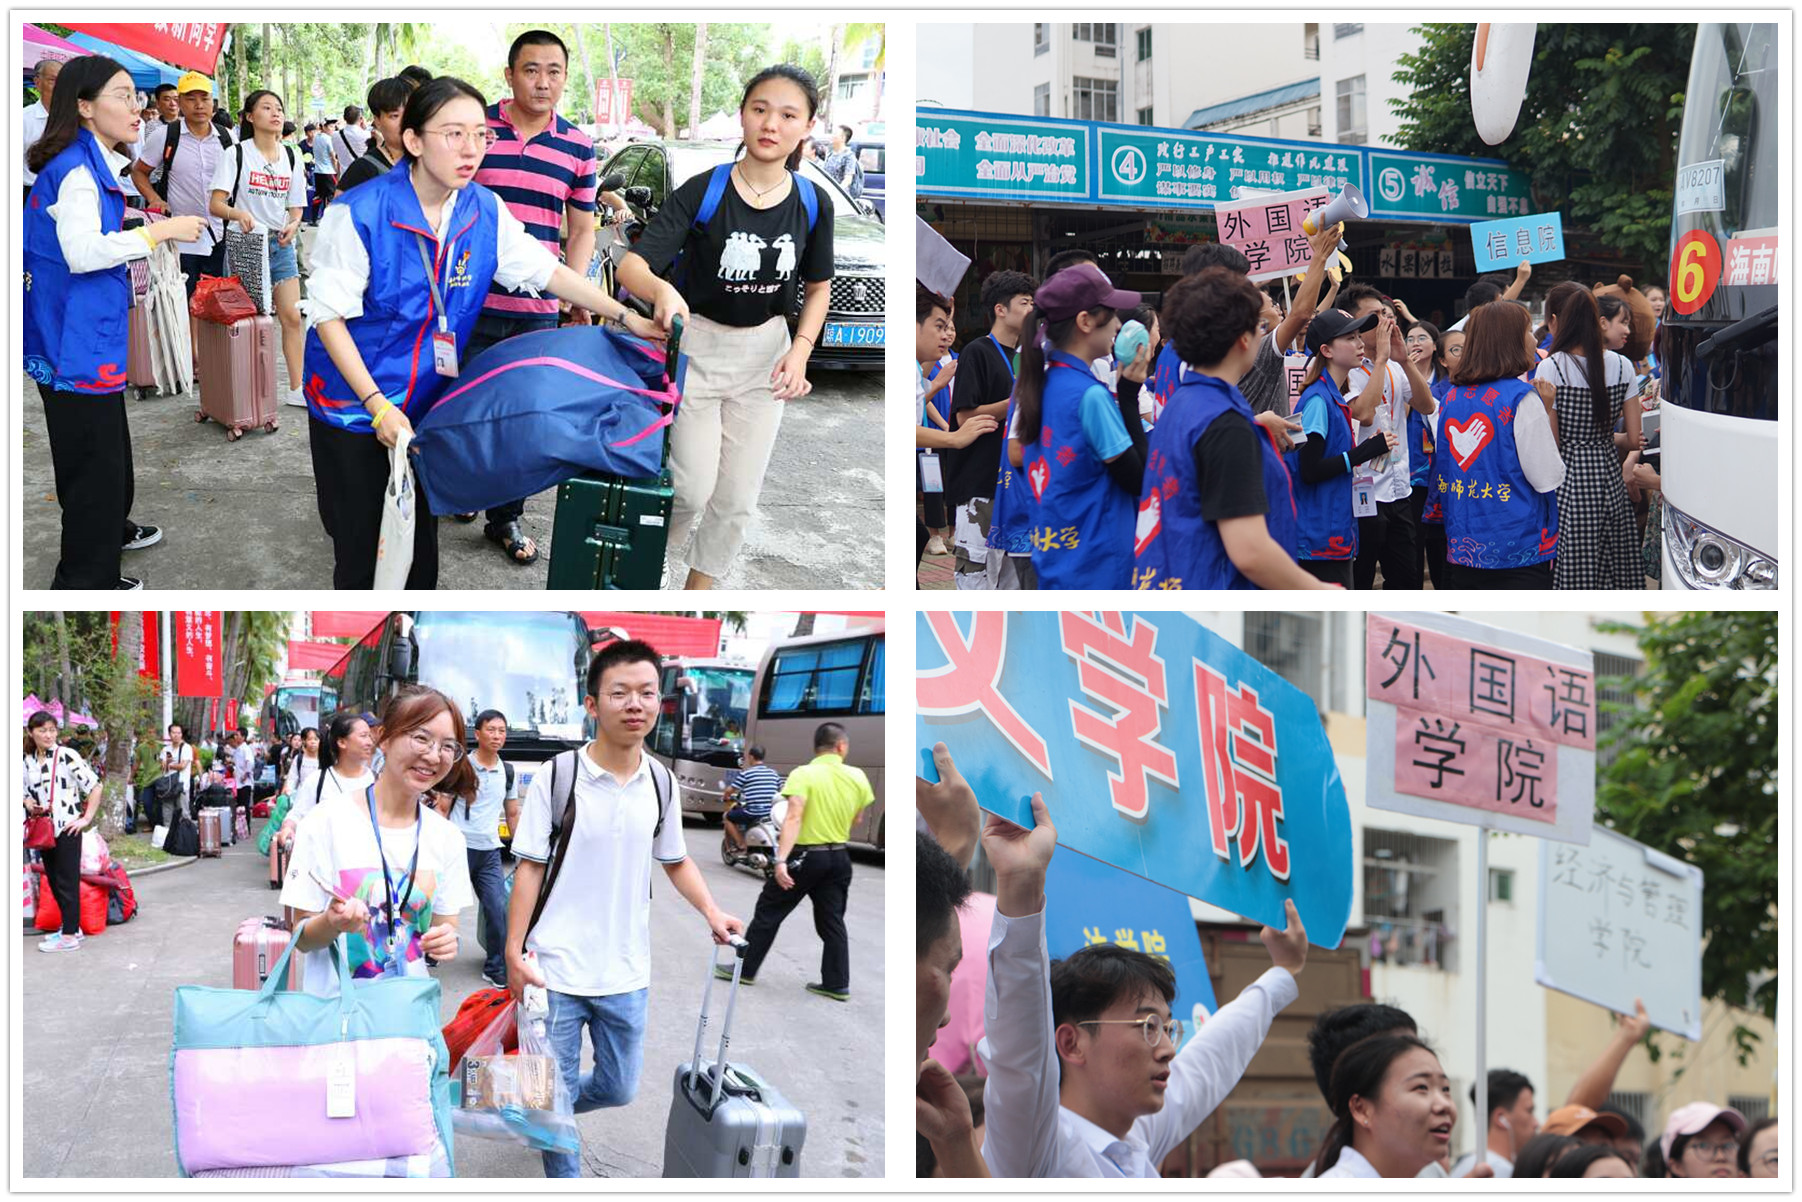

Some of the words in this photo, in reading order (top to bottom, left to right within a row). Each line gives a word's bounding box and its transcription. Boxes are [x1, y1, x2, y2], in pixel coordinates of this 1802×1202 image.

[974, 131, 1076, 157] 全面深化改革
[975, 159, 1077, 184] 全面从严治党
[1156, 163, 1217, 181] 严以修身
[1410, 164, 1460, 211] 诚信
[1464, 170, 1509, 192] 信立天下
[1487, 195, 1529, 215] 自强不息
[1245, 234, 1311, 270] 学院
[1486, 225, 1556, 260] 信息院
[1381, 254, 1453, 276] 水果沙拉
[1676, 240, 1707, 303] 6
[1729, 244, 1778, 285] 海南
[1381, 627, 1591, 739] 外国语
[1413, 718, 1545, 808] 学院
[1552, 844, 1690, 930] 经济与管理
[1588, 916, 1652, 972] 学院
